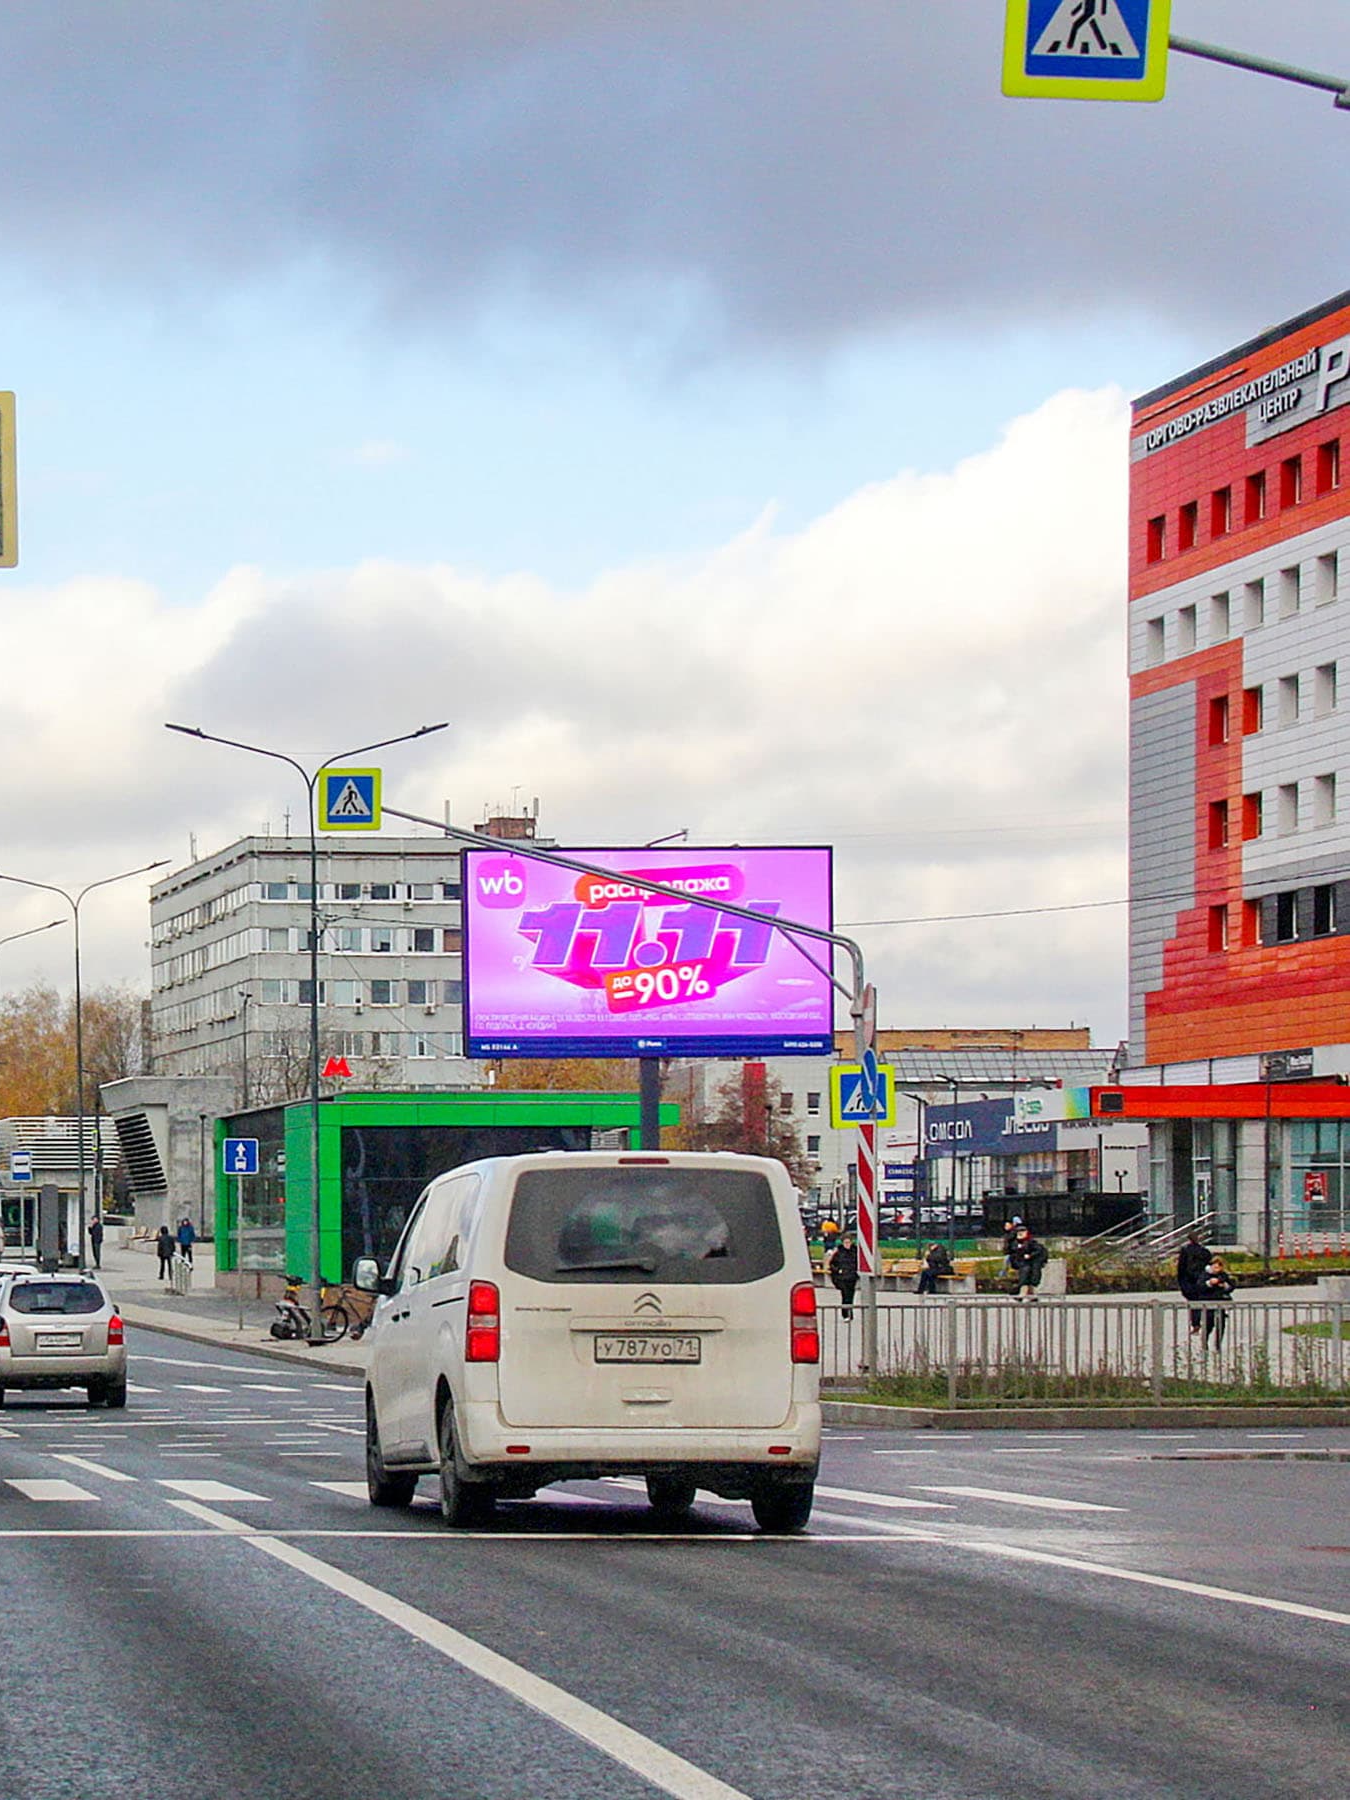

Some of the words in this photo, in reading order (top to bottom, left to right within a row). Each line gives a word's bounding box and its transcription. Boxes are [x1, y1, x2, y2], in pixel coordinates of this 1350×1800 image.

[1144, 347, 1318, 450] ТОРГОВО-РАЗВЛЕКАТЕЛЬНЫЙ
[1258, 387, 1299, 424] ЦЕНТР
[479, 869, 523, 895] wb
[516, 901, 782, 968] 11.11
[612, 975, 632, 989] до
